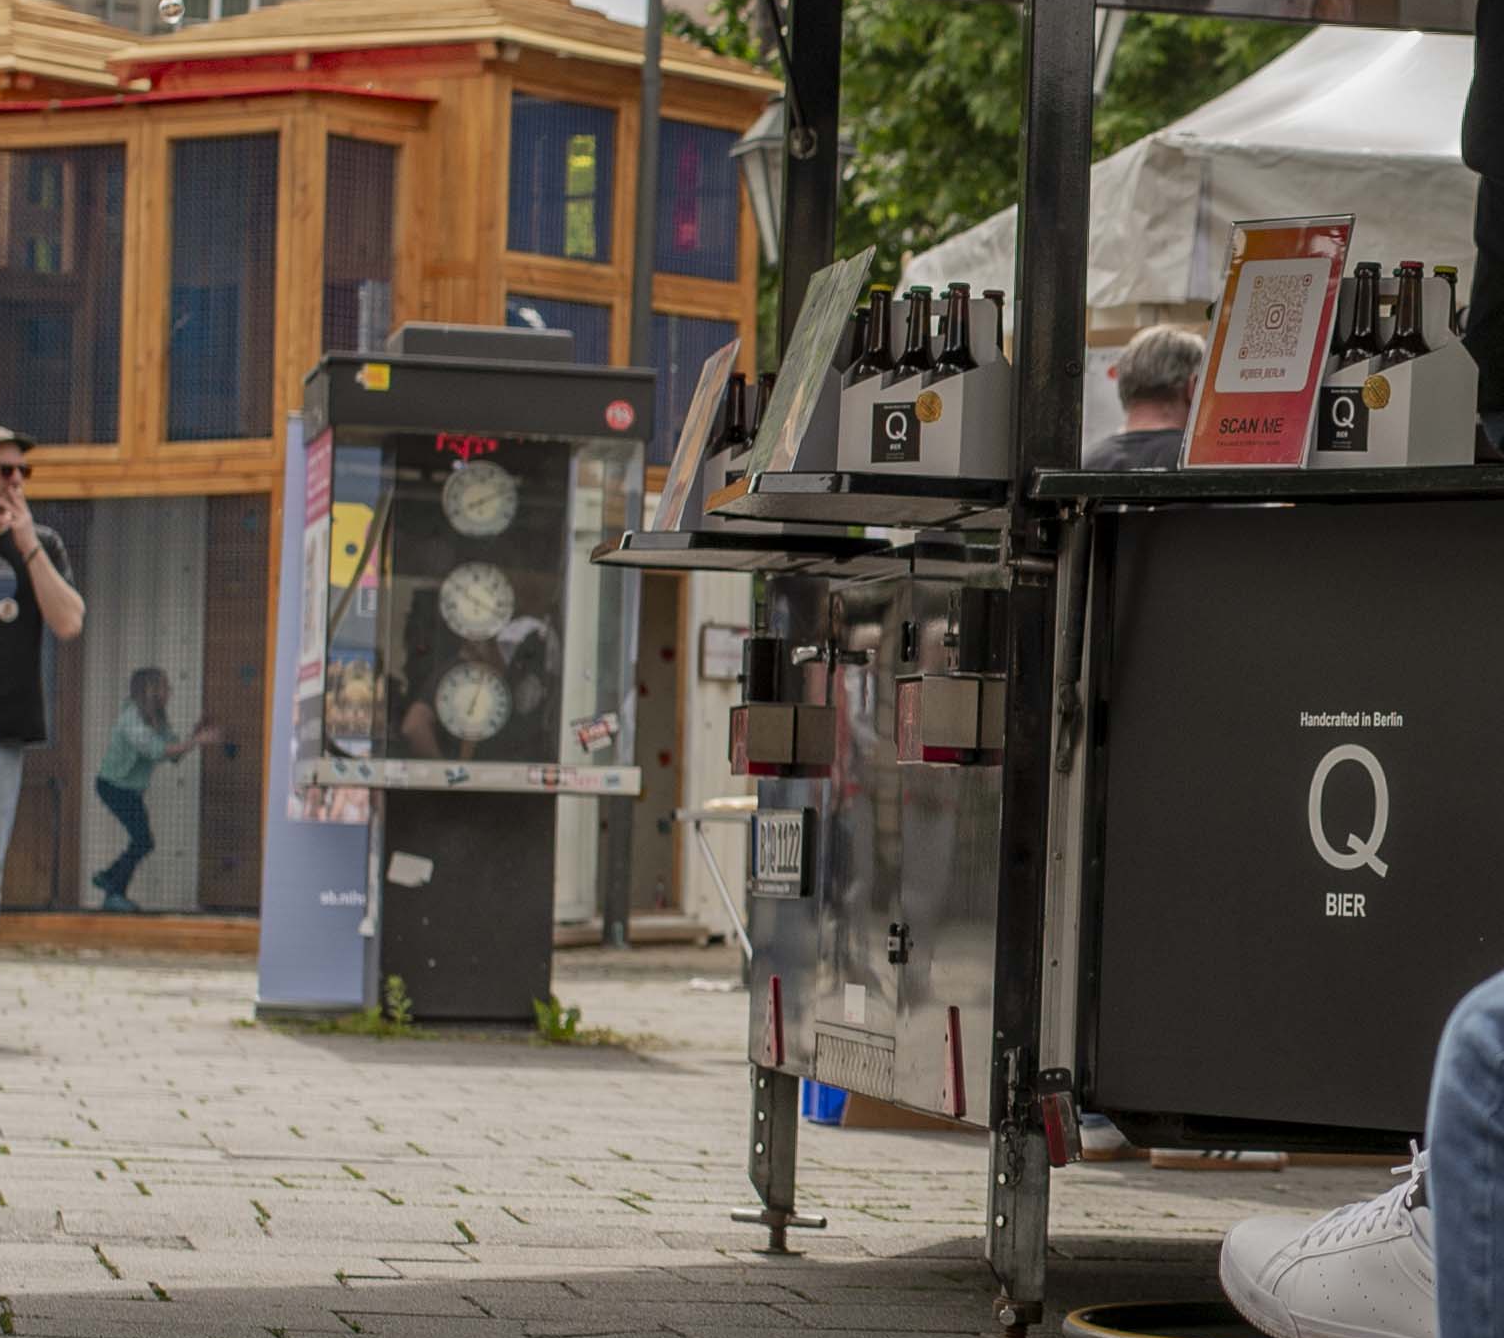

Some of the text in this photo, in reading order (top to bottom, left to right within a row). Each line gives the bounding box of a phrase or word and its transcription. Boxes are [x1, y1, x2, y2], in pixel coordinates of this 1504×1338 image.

[885, 411, 908, 442] Q
[1218, 416, 1285, 435] SCAN ME
[1332, 396, 1355, 429] Q
[1300, 711, 1404, 728] Handcrafted in Berlin
[1308, 743, 1390, 878] Q
[1325, 892, 1366, 918] BIER
